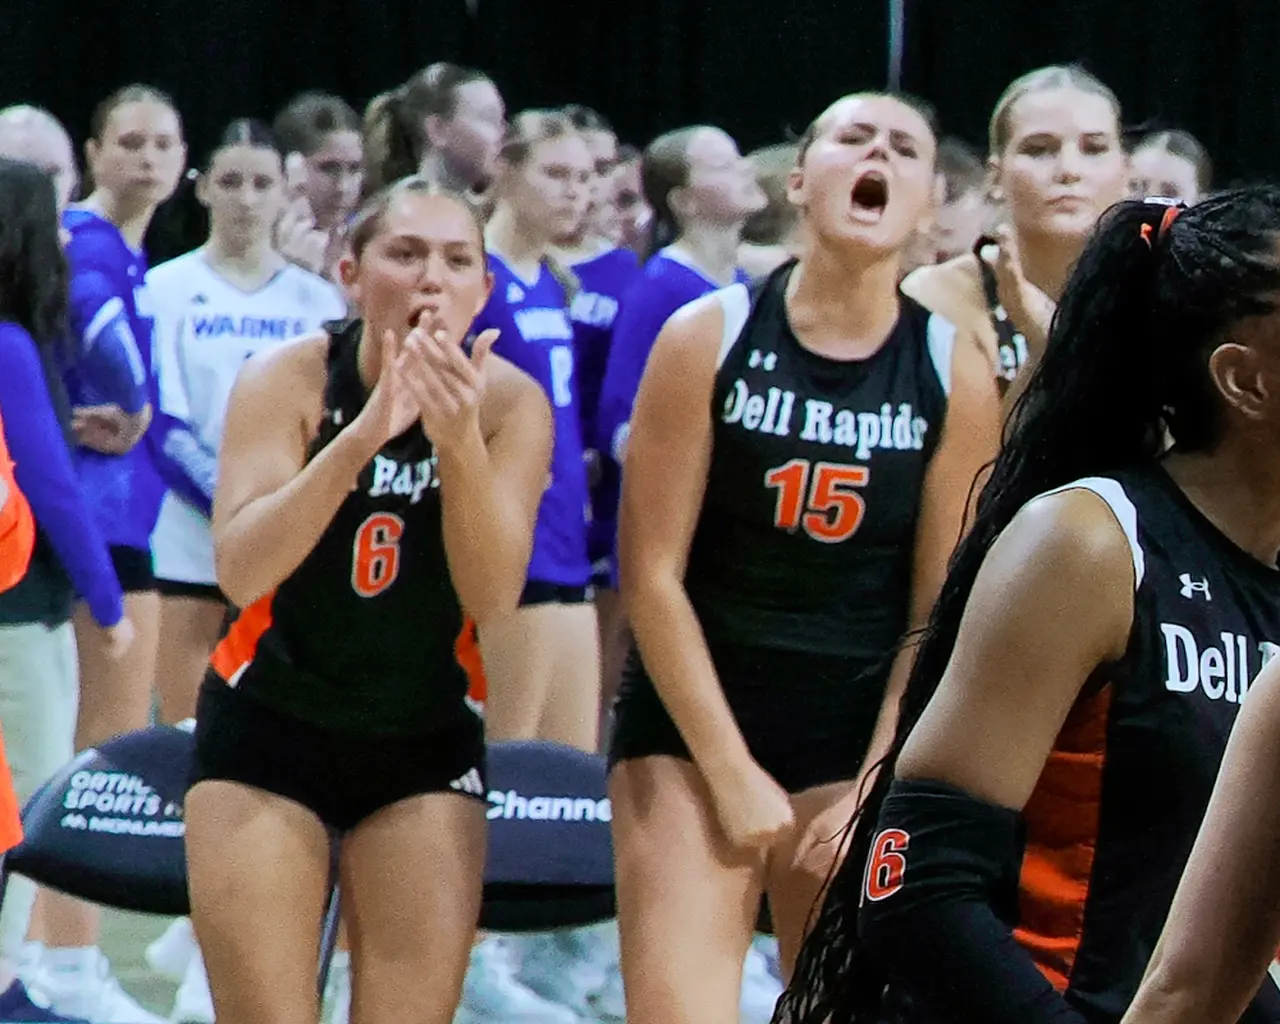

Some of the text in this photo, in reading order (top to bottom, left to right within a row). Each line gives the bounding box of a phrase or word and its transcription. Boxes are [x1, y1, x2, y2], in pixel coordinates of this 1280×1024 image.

[721, 378, 796, 436] Dell
[764, 458, 869, 543] 15
[351, 511, 405, 598] 6
[1160, 622, 1250, 705] Dell
[63, 788, 162, 816] SPORTS
[866, 828, 911, 901] 6
